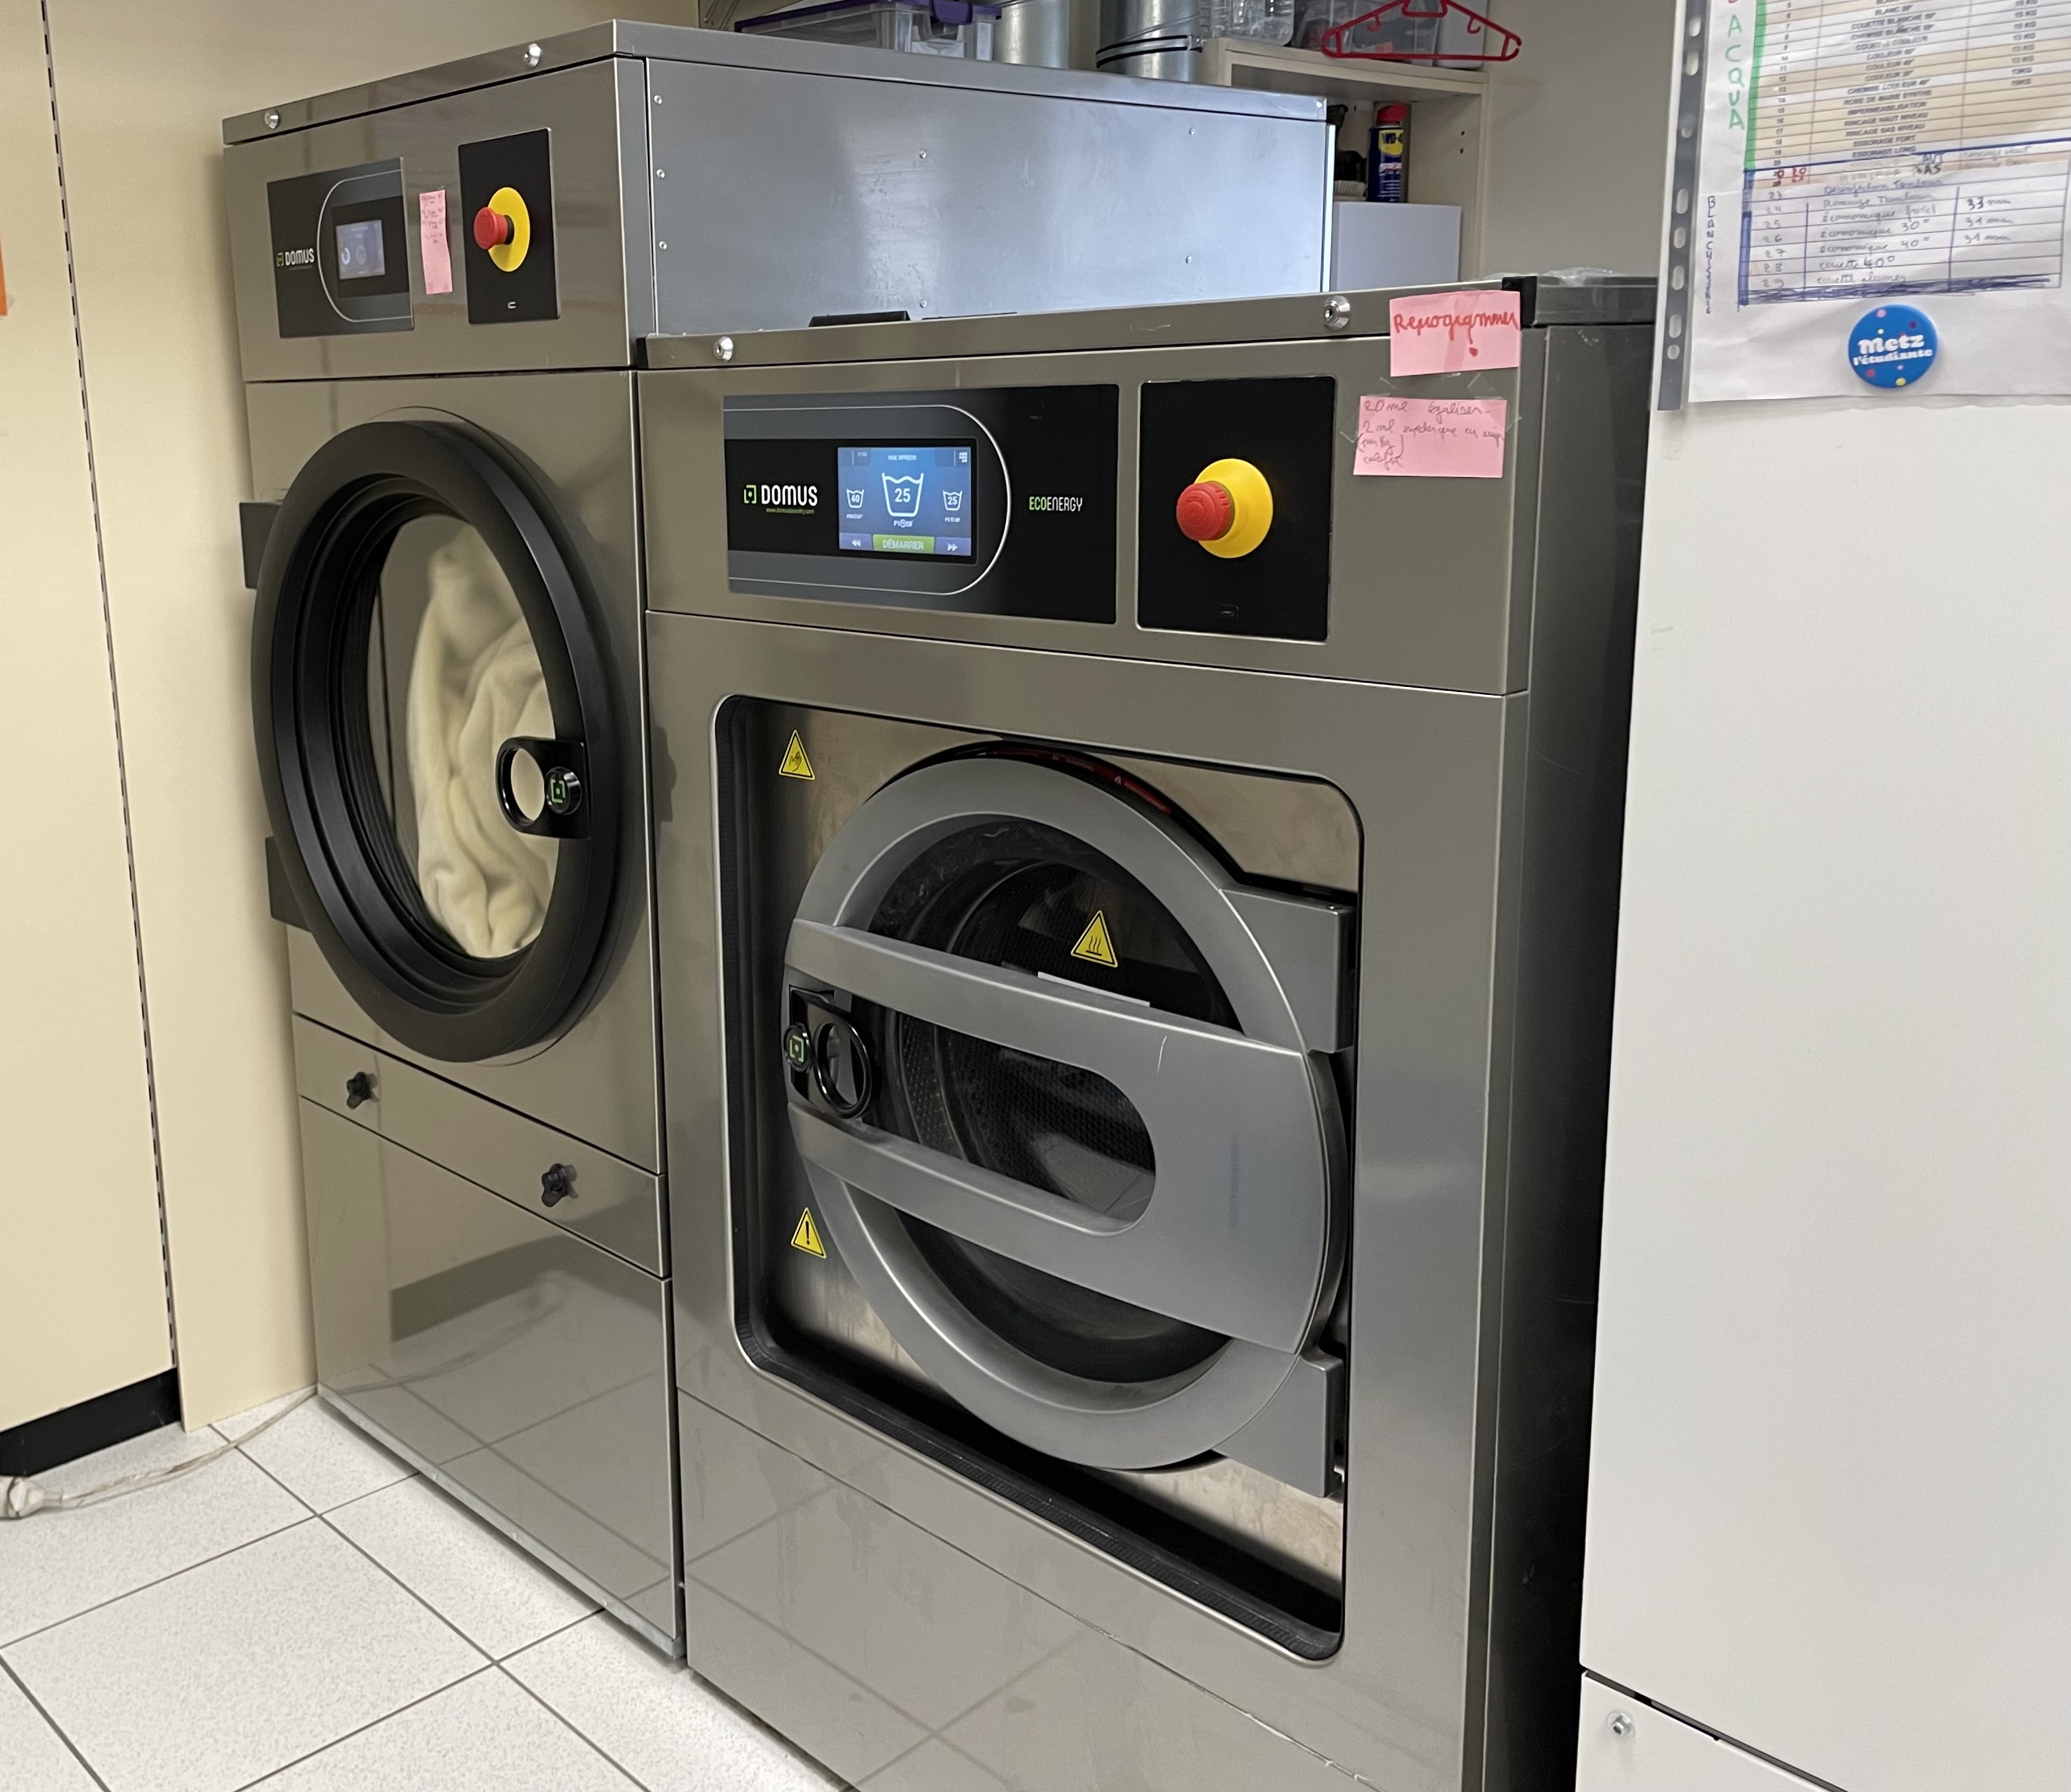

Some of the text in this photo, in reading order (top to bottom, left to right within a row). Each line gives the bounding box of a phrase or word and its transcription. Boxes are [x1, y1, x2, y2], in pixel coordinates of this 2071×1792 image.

[1765, 220, 1781, 228] 25
[1763, 235, 1782, 244] 26
[285, 248, 314, 265] DOMUS
[1765, 248, 1786, 259] 27
[1764, 263, 1782, 273] 28
[1763, 279, 1784, 289] 29
[761, 484, 818, 507] DOMUS
[851, 494, 860, 503] 40
[895, 488, 911, 503] 25
[947, 496, 958, 506] 25
[1029, 496, 1083, 512] ECOENERGY
[882, 539, 924, 551] DÉMARRER
